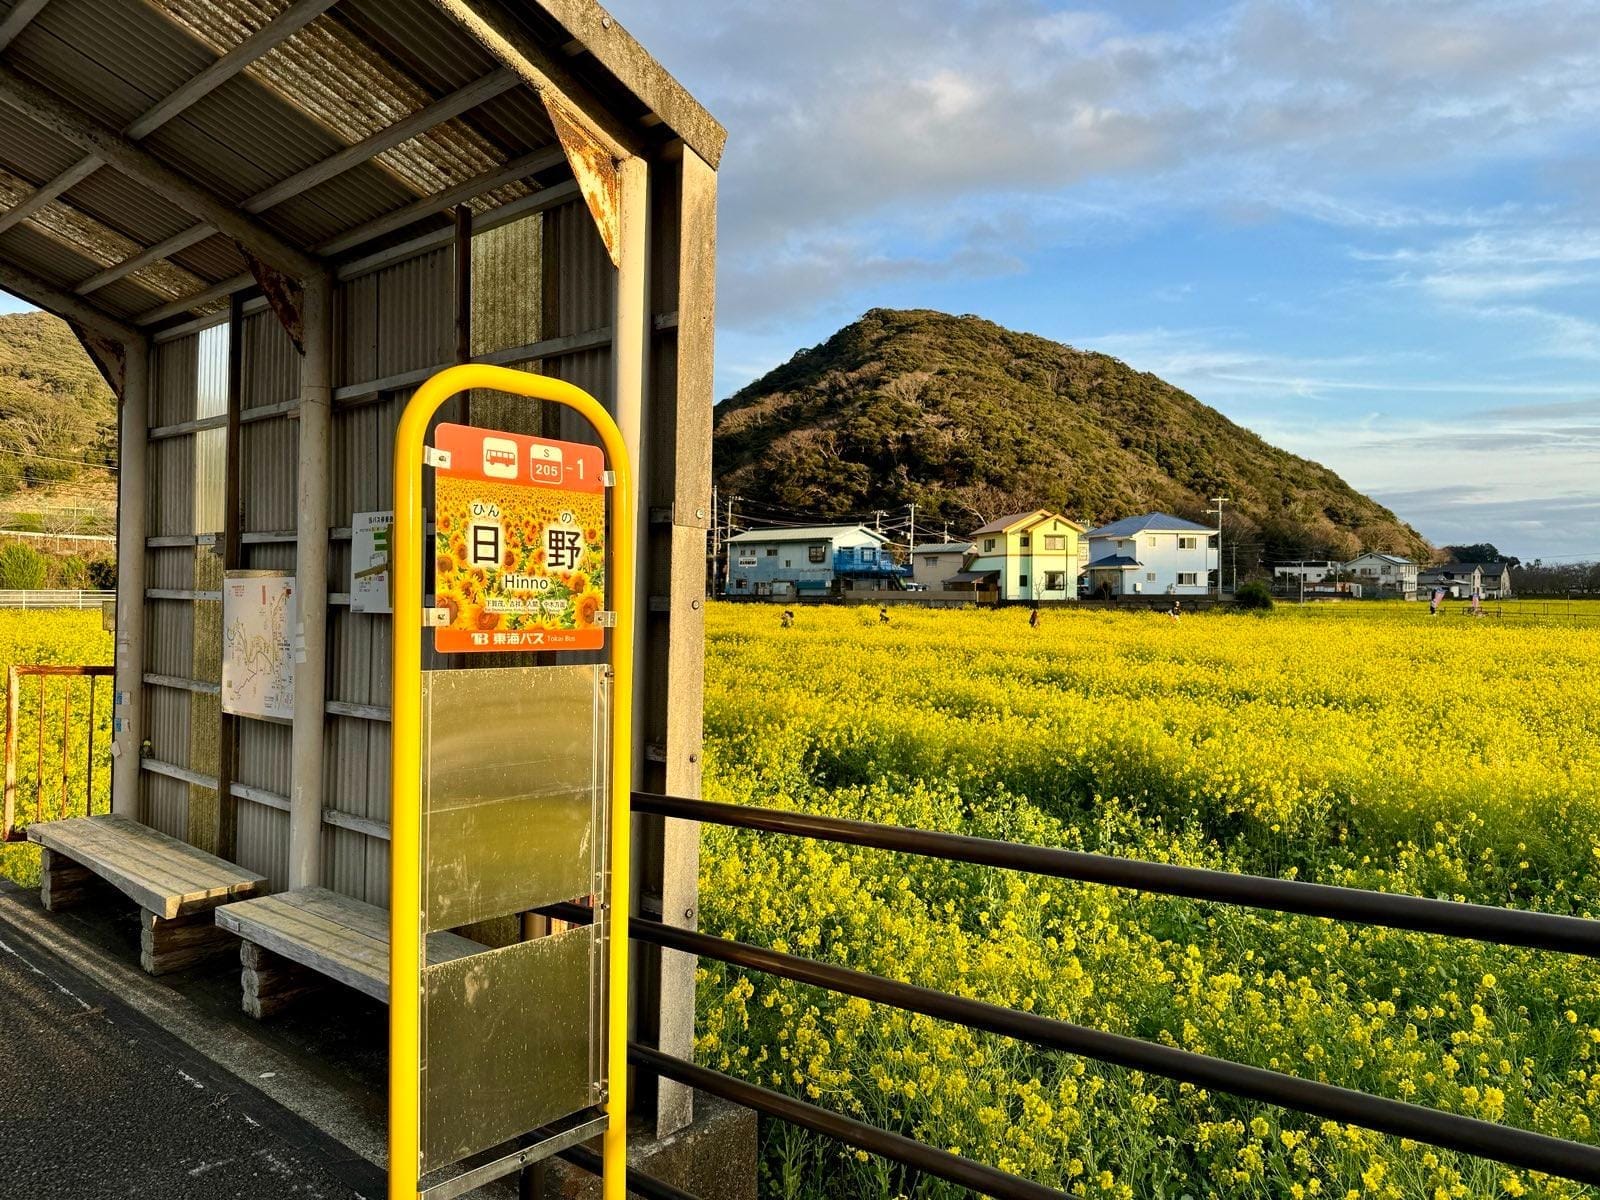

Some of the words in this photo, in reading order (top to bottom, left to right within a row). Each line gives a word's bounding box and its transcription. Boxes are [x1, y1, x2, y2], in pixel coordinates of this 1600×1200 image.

[543, 448, 550, 458] S
[535, 463, 558, 477] 205
[473, 504, 500, 517] ひん
[473, 525, 581, 570] 日野
[505, 575, 549, 589] Hinno
[493, 632, 544, 645] 東海バス
